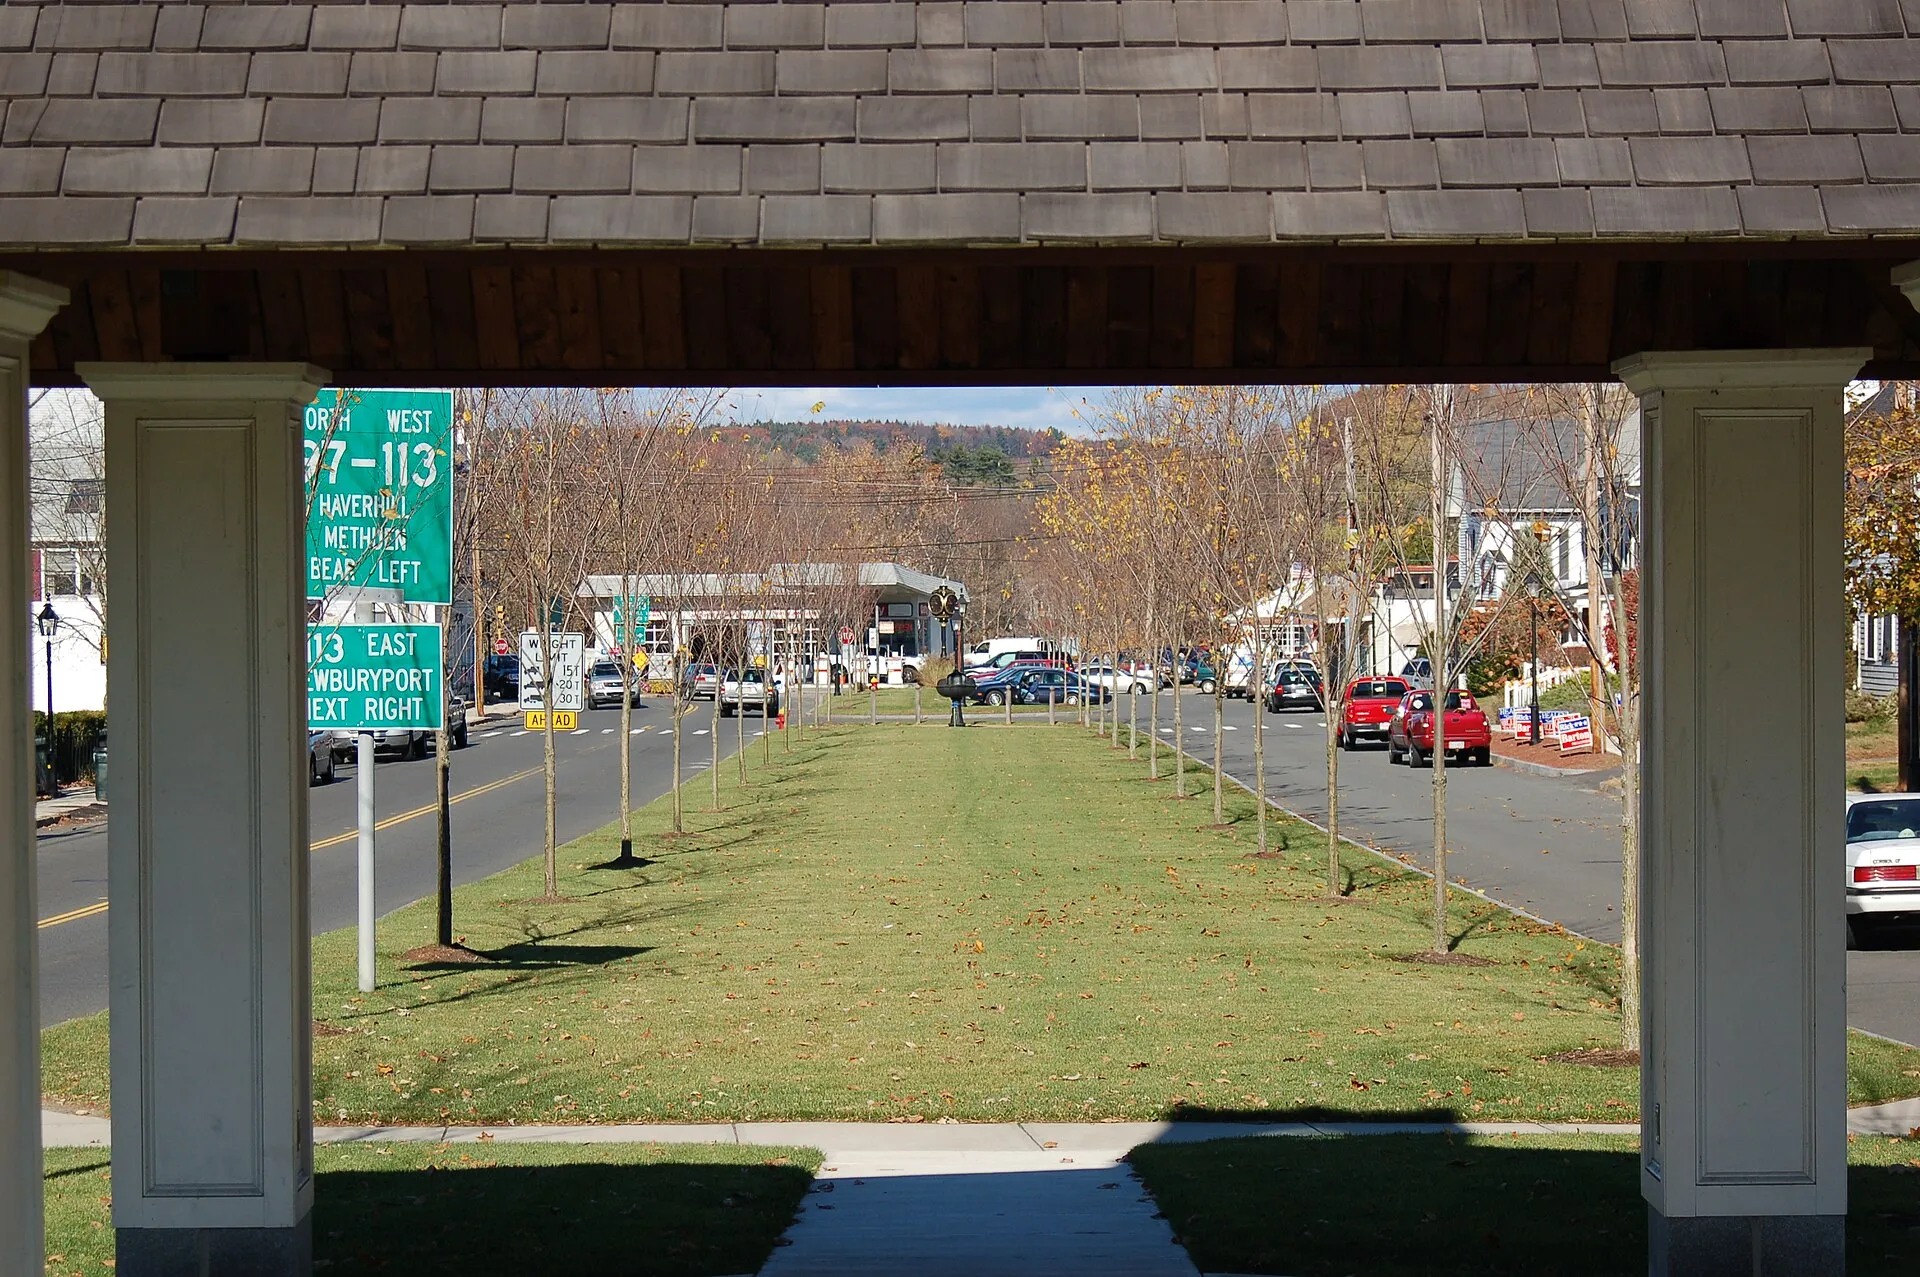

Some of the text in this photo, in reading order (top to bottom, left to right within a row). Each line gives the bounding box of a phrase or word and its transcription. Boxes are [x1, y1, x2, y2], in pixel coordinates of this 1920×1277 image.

[386, 409, 433, 433] WEST
[310, 556, 421, 584] BEAR LEFT
[367, 633, 417, 656] EAST
[529, 639, 576, 649] WGHT
[535, 652, 568, 662] LIT
[365, 697, 423, 721] RIGHT
[531, 714, 571, 726] AHAD
